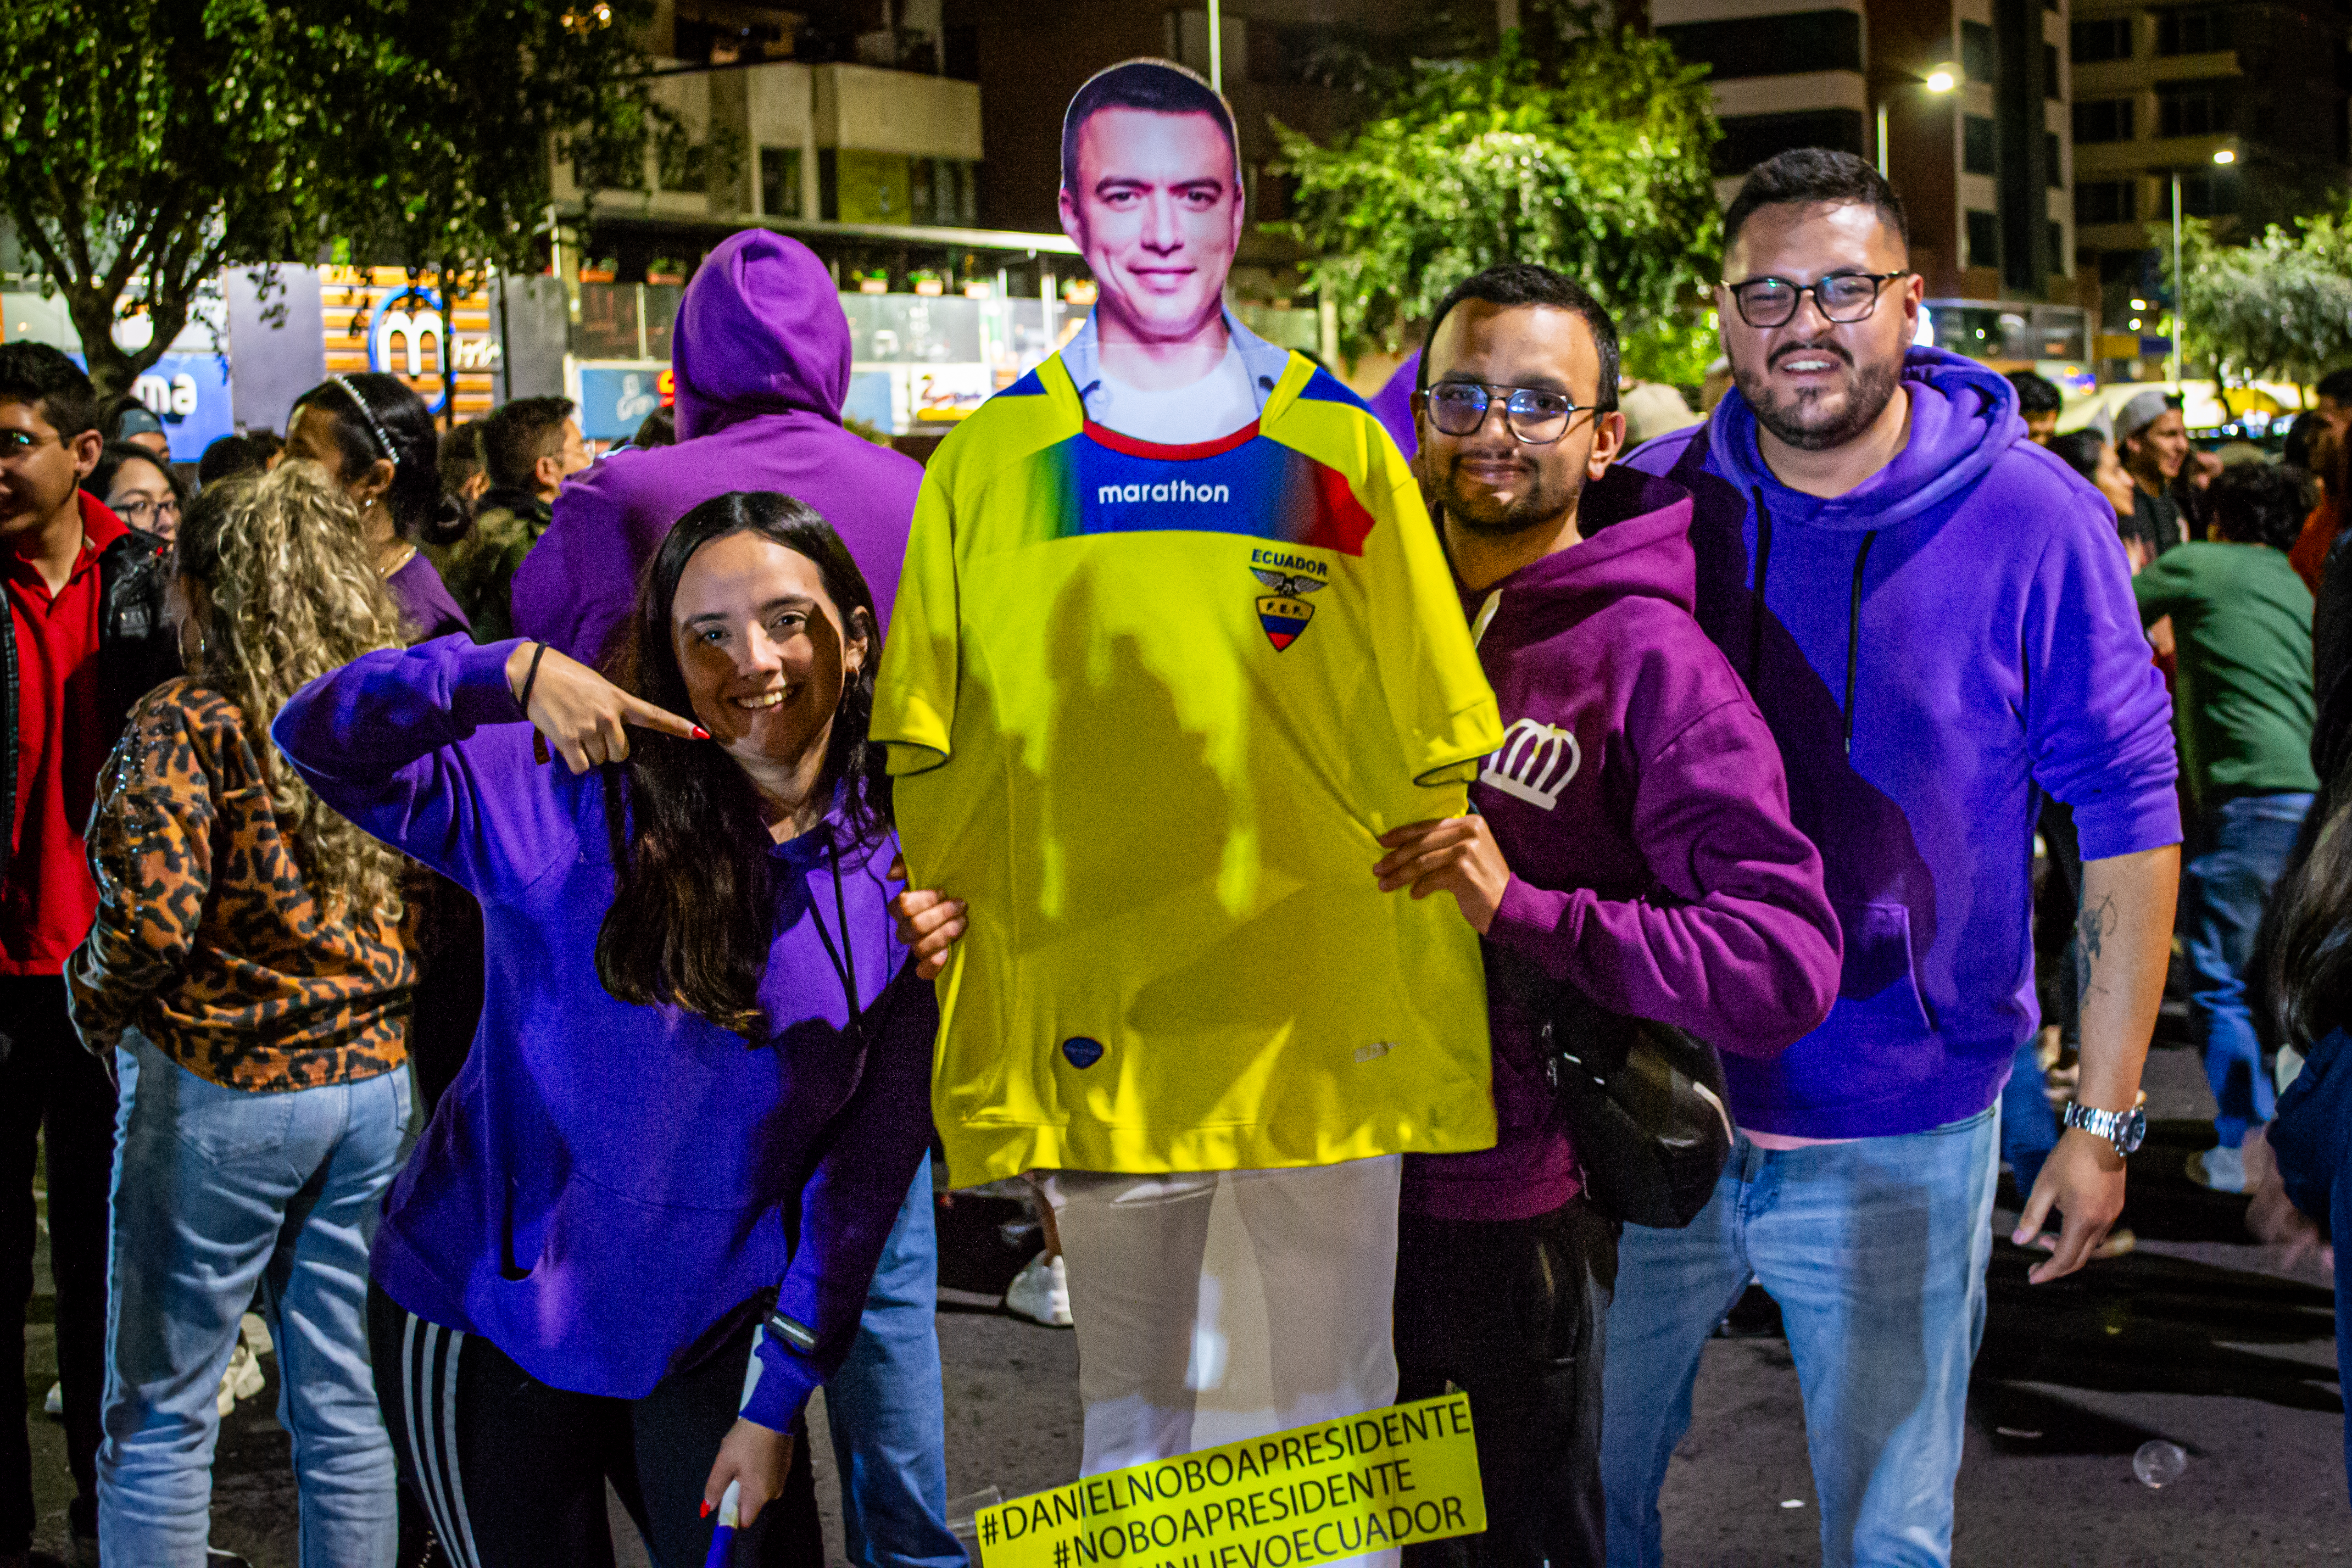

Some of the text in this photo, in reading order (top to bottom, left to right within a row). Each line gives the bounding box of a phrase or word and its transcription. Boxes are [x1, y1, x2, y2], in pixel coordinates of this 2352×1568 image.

[1098, 479, 1229, 505] marathon
[1251, 548, 1328, 576] ECUADOR
[982, 1401, 1472, 1547] #DANIELNOBOAPRESIDENTE
[1054, 1458, 1415, 1568] #NOBOAPRESIDENTE
